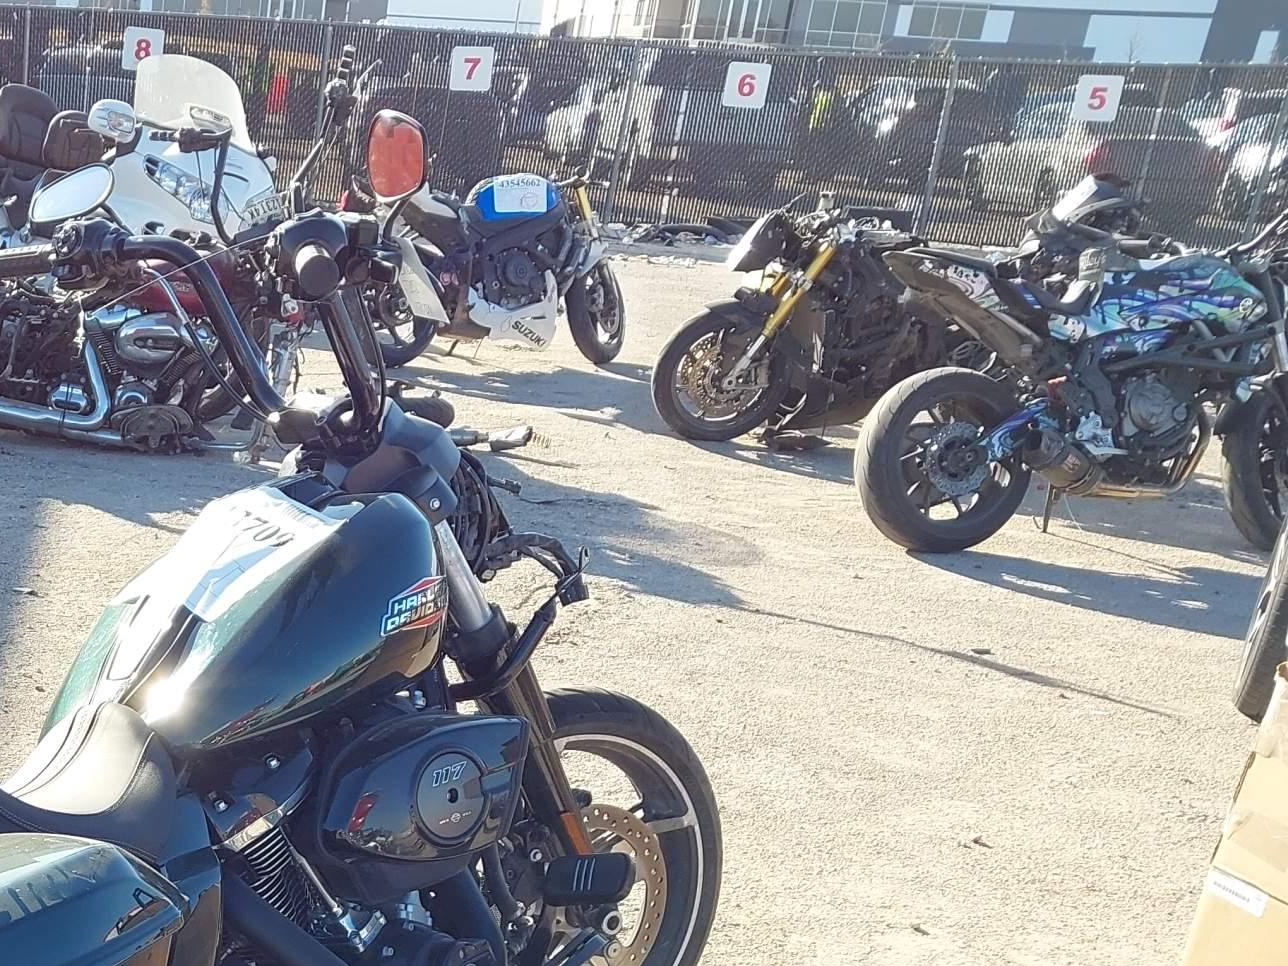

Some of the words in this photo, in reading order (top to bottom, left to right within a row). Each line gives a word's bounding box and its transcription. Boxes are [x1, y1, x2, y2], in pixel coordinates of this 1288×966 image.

[135, 38, 151, 60] 8
[464, 57, 481, 80] 7
[738, 73, 756, 97] 6
[1088, 87, 1108, 110] 5
[511, 320, 546, 348] SUZUKI
[432, 761, 467, 787] 117
